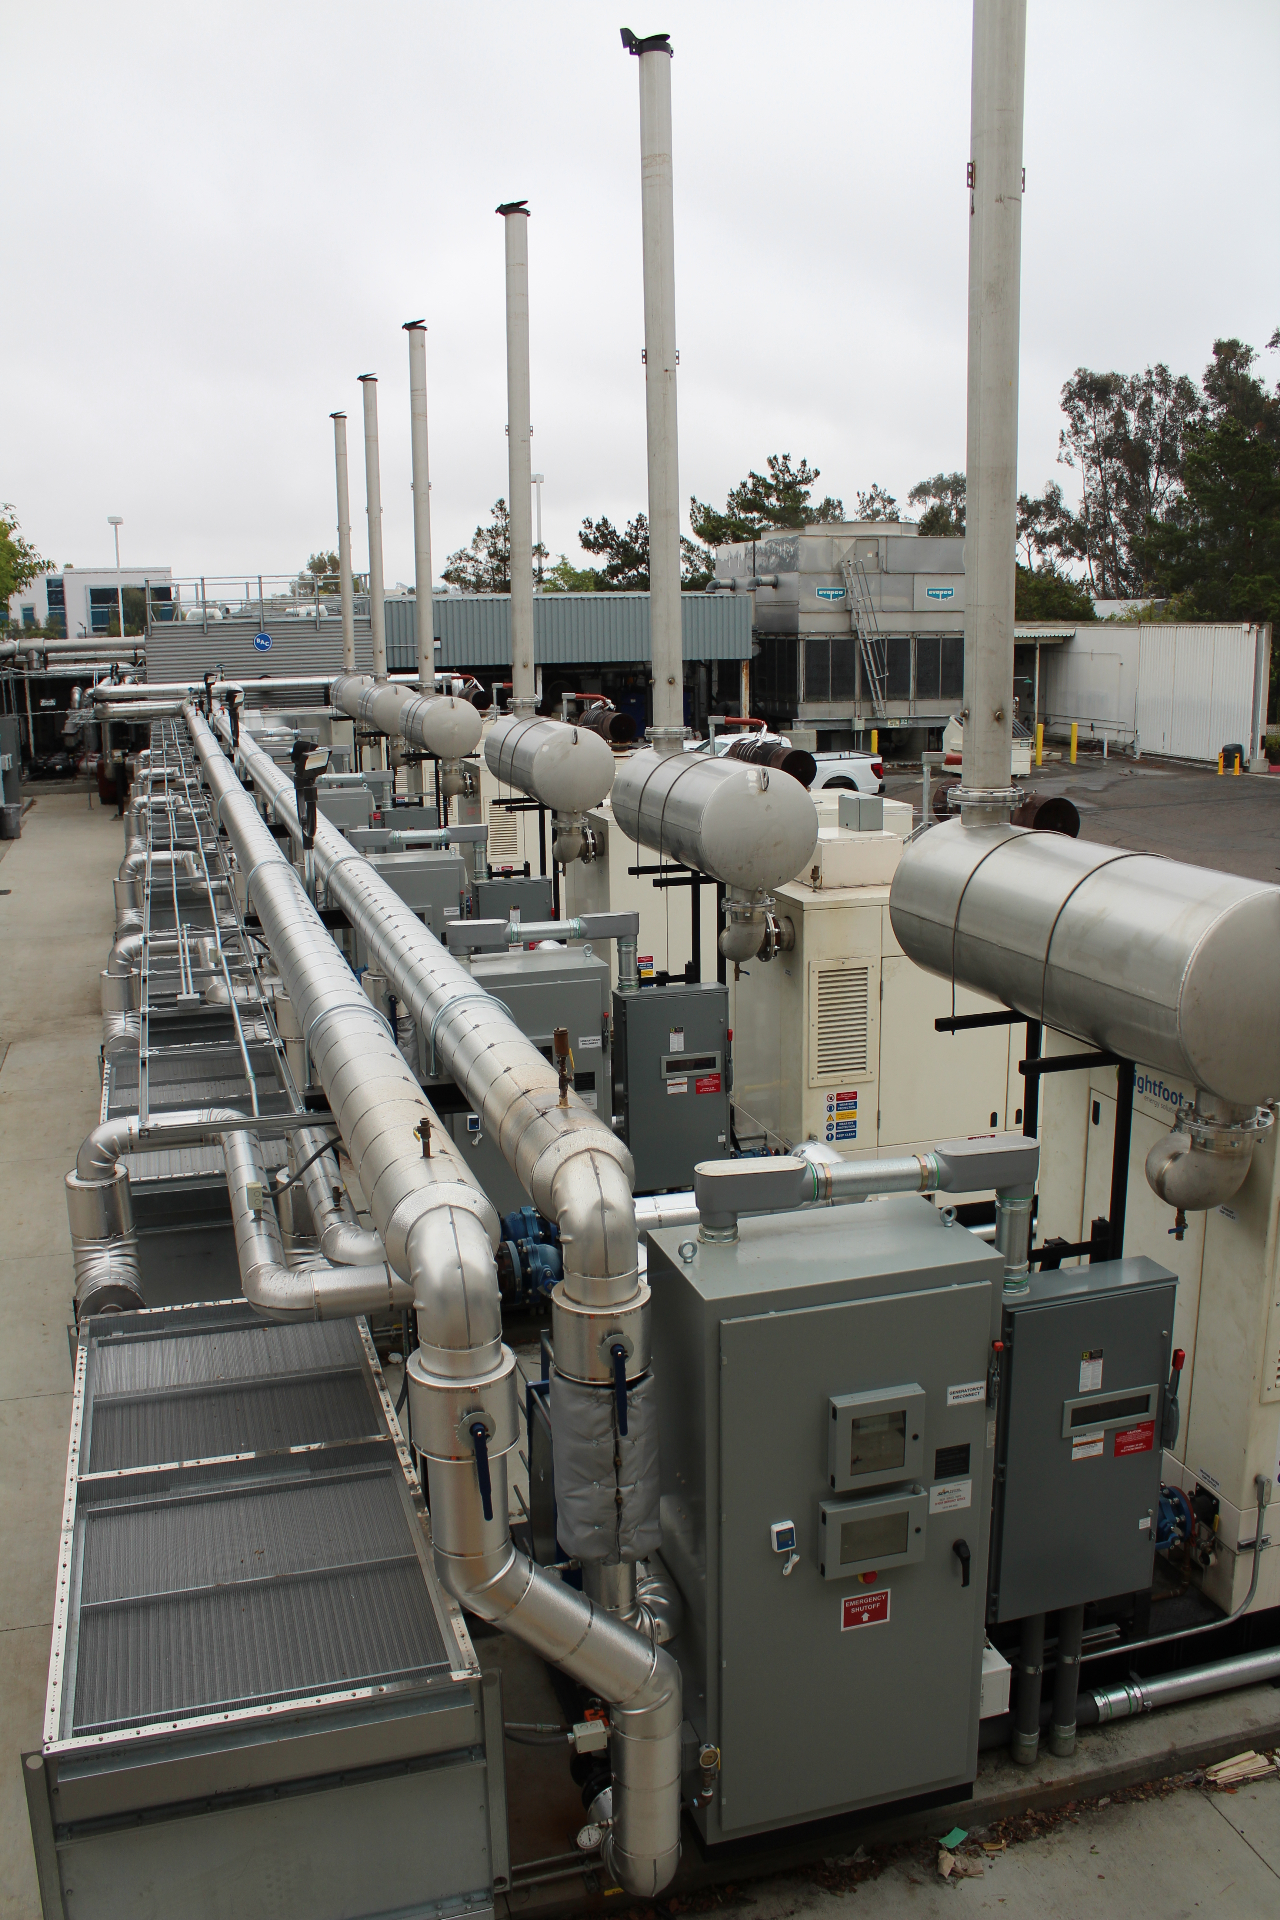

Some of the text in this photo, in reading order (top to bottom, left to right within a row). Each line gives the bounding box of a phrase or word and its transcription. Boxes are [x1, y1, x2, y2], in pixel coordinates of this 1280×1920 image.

[256, 637, 270, 647] BAC
[1133, 1069, 1184, 1107] ightfoot
[1144, 1095, 1160, 1108] energy
[952, 1391, 980, 1400] DISCONNECT
[845, 1594, 886, 1607] EMERGENCY
[851, 1602, 880, 1614] SHUTOFF
